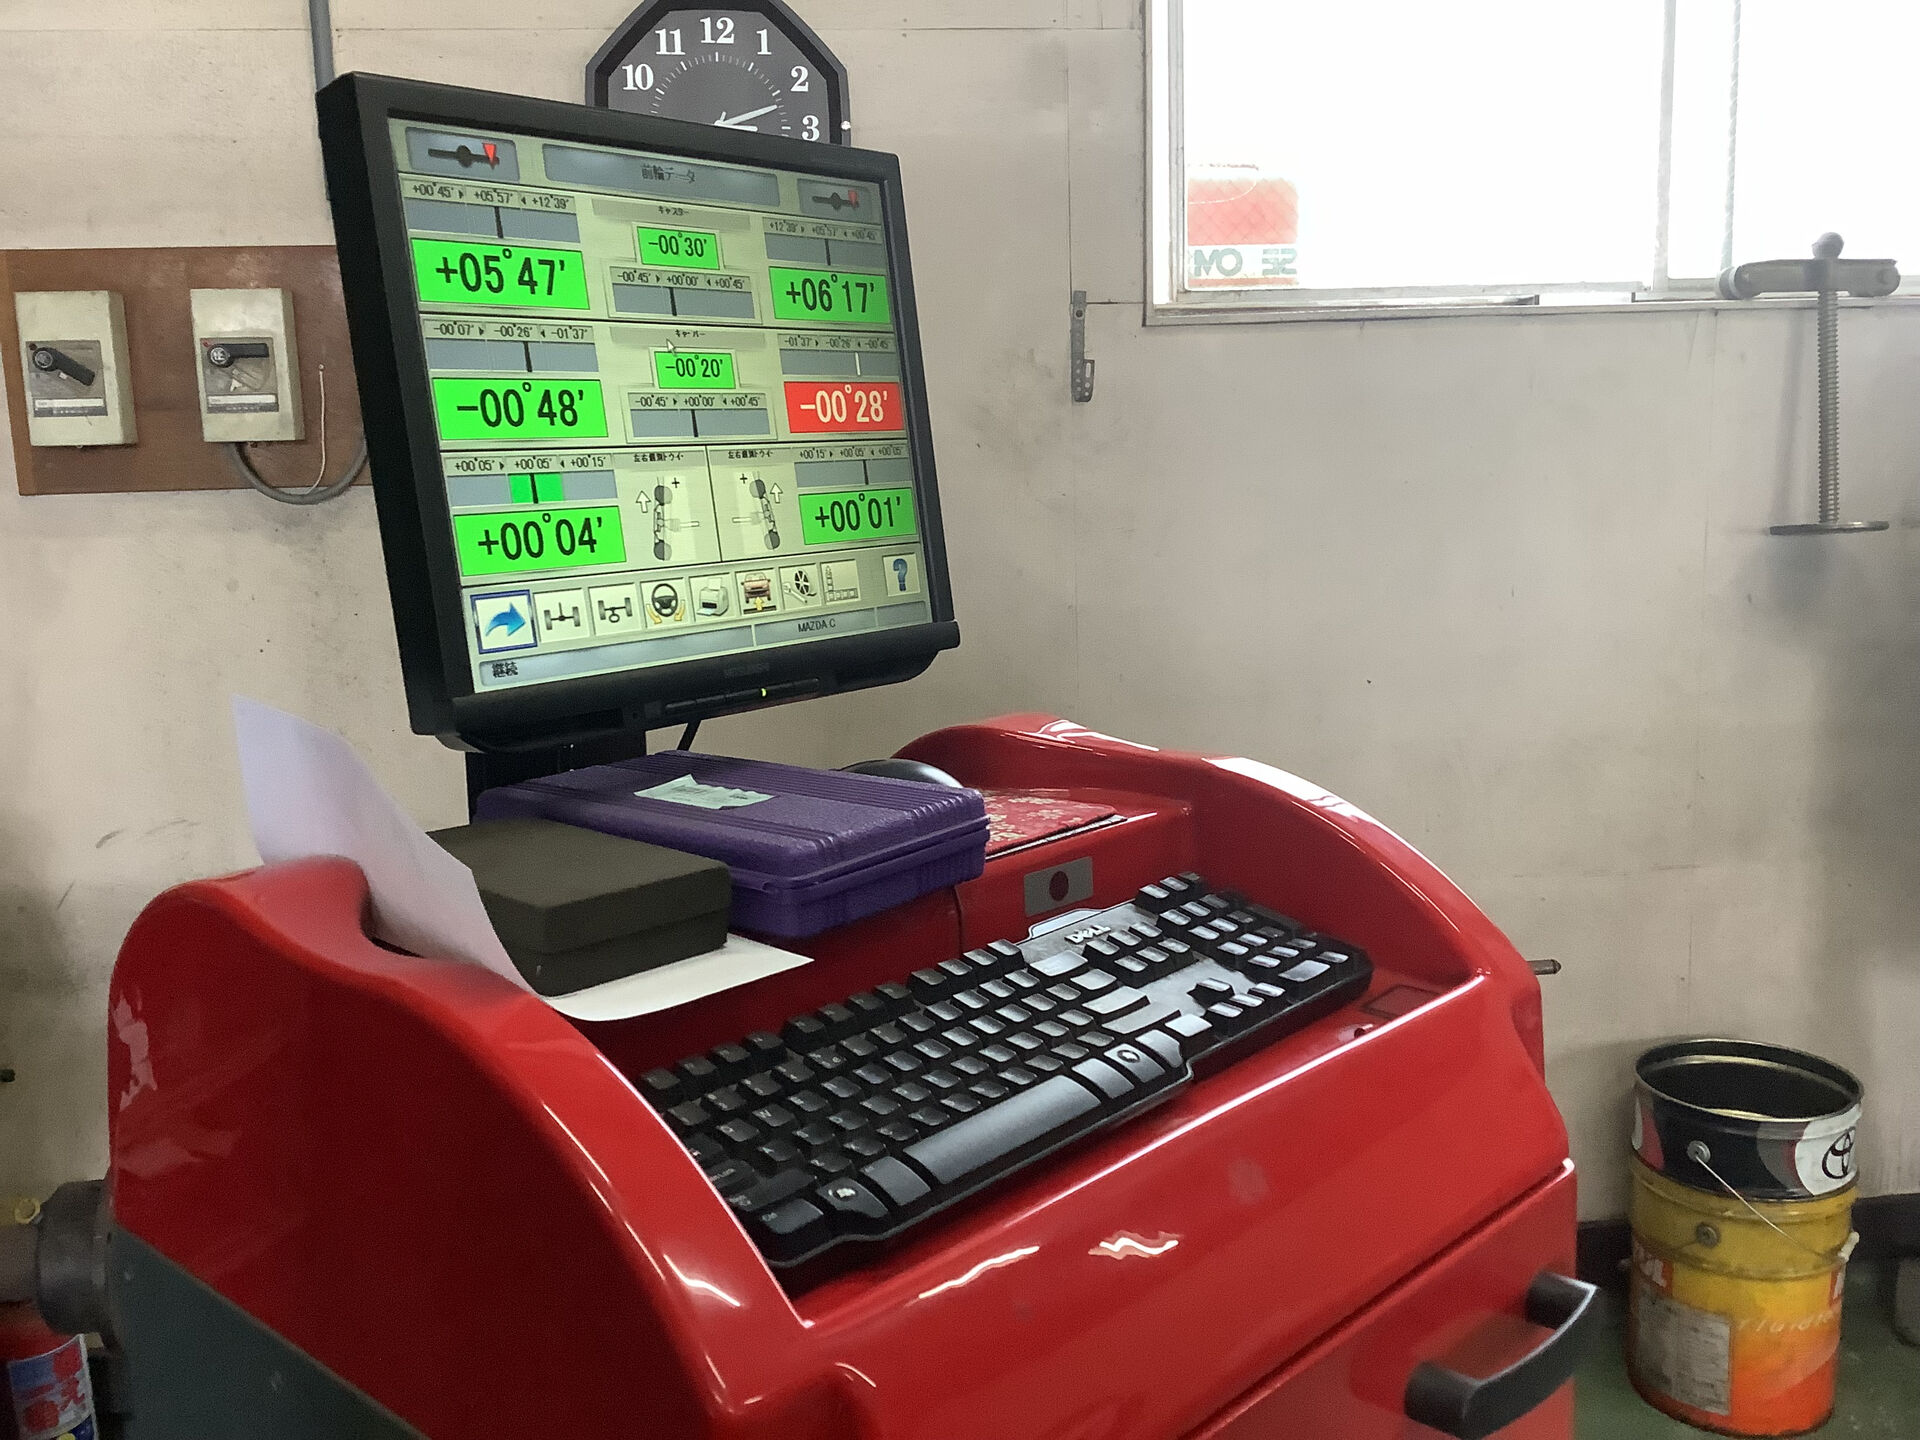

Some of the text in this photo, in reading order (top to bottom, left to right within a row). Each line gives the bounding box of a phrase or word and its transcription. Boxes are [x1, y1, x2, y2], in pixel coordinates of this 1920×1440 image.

[655, 28, 686, 55] 11
[700, 17, 735, 44] 12
[756, 29, 772, 55] 1
[621, 63, 654, 91] 10
[790, 66, 809, 92] 2
[801, 115, 820, 142] 3
[798, 620, 827, 633] MAZDA
